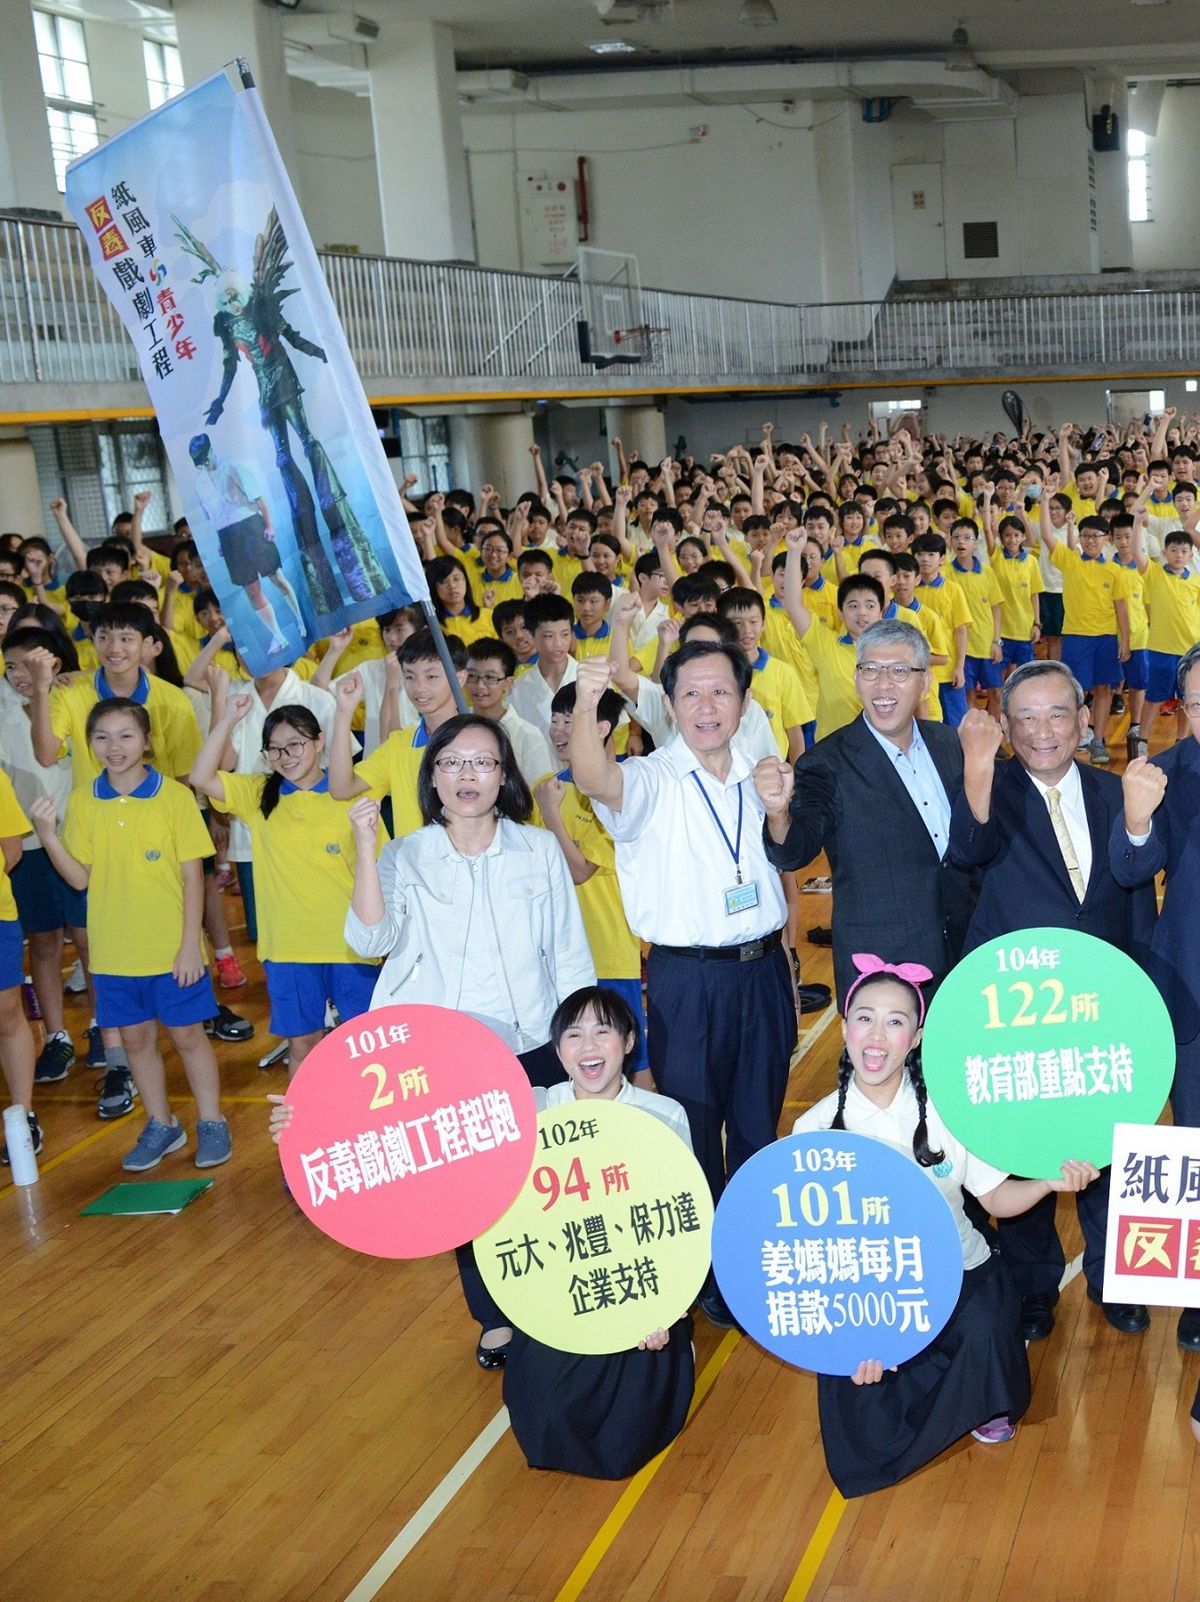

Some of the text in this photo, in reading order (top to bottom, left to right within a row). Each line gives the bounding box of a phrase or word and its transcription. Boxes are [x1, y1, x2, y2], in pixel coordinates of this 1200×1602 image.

[111, 180, 197, 361] 紙風車 青少年
[996, 946, 1061, 973] 104年
[980, 978, 1099, 1029] 122所
[345, 1023, 411, 1059] 101年
[964, 1043, 1134, 1105] 教育部重點支持
[300, 1089, 521, 1207] 反毒戲劇工程起跑
[538, 1119, 600, 1150] 102年
[792, 1148, 857, 1173] 103年
[772, 1180, 890, 1227] 101所
[761, 1234, 924, 1286] 姜媽媽每月
[568, 1256, 660, 1316] 企業支持
[766, 1287, 931, 1336] 捐款5000元
